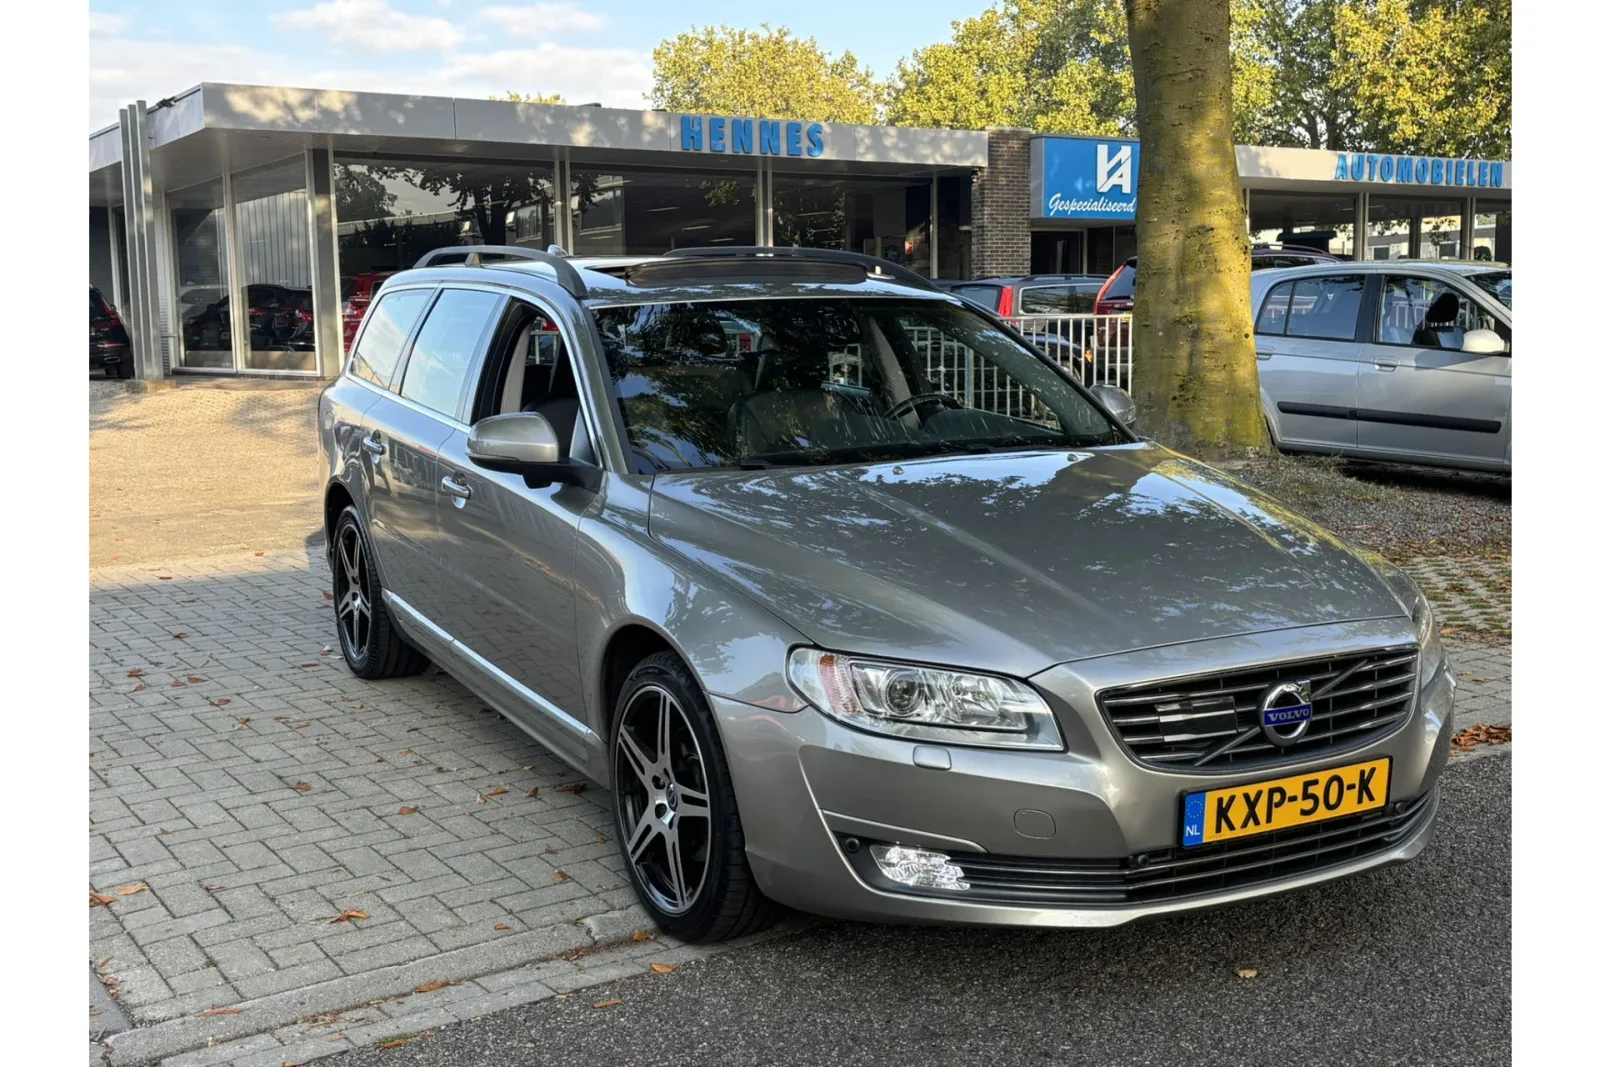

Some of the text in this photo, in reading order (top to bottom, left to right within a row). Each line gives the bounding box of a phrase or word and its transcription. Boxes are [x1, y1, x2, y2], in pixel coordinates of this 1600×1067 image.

[681, 115, 824, 157] HENNES
[1335, 153, 1503, 187] AUTOMOBIELEN
[1048, 193, 1137, 216] Gespecialiseerd
[1267, 708, 1310, 722] VOLVO
[1215, 767, 1376, 834] KXP-50-K
[1185, 824, 1201, 837] NL
